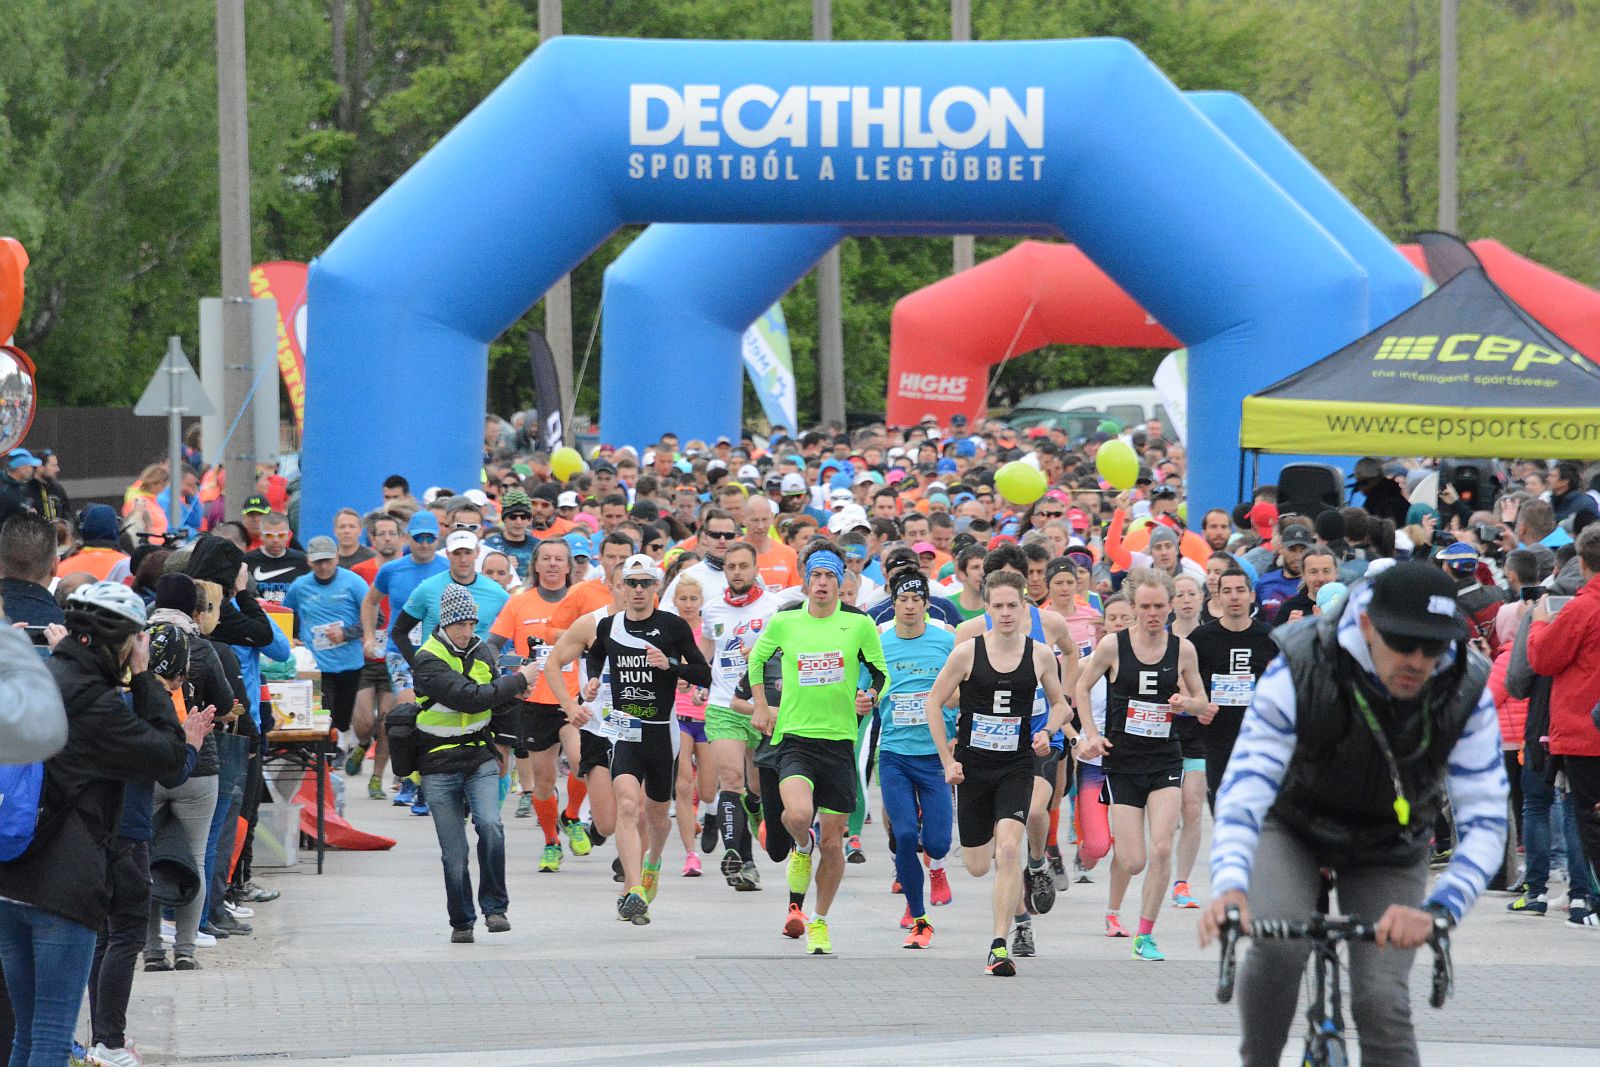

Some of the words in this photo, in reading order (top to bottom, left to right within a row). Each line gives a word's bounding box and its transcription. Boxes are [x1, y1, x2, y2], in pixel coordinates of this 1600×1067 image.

[630, 84, 1045, 149] DECATHLON
[628, 149, 800, 181] SPORTBÓL
[819, 154, 835, 181] A
[855, 150, 1046, 181] LEGTÖBBET
[899, 372, 969, 394] HIGH5
[1371, 370, 1395, 378] the
[1399, 370, 1470, 385] intelligent
[1473, 374, 1560, 387] sportswear
[902, 579, 922, 591] cep
[801, 659, 840, 671] 2002
[619, 671, 653, 683] HUN
[1138, 671, 1158, 695] E
[1214, 682, 1251, 691] 2752
[992, 690, 1011, 714] E
[1133, 708, 1167, 722] 2125
[976, 722, 1016, 735] 2746
